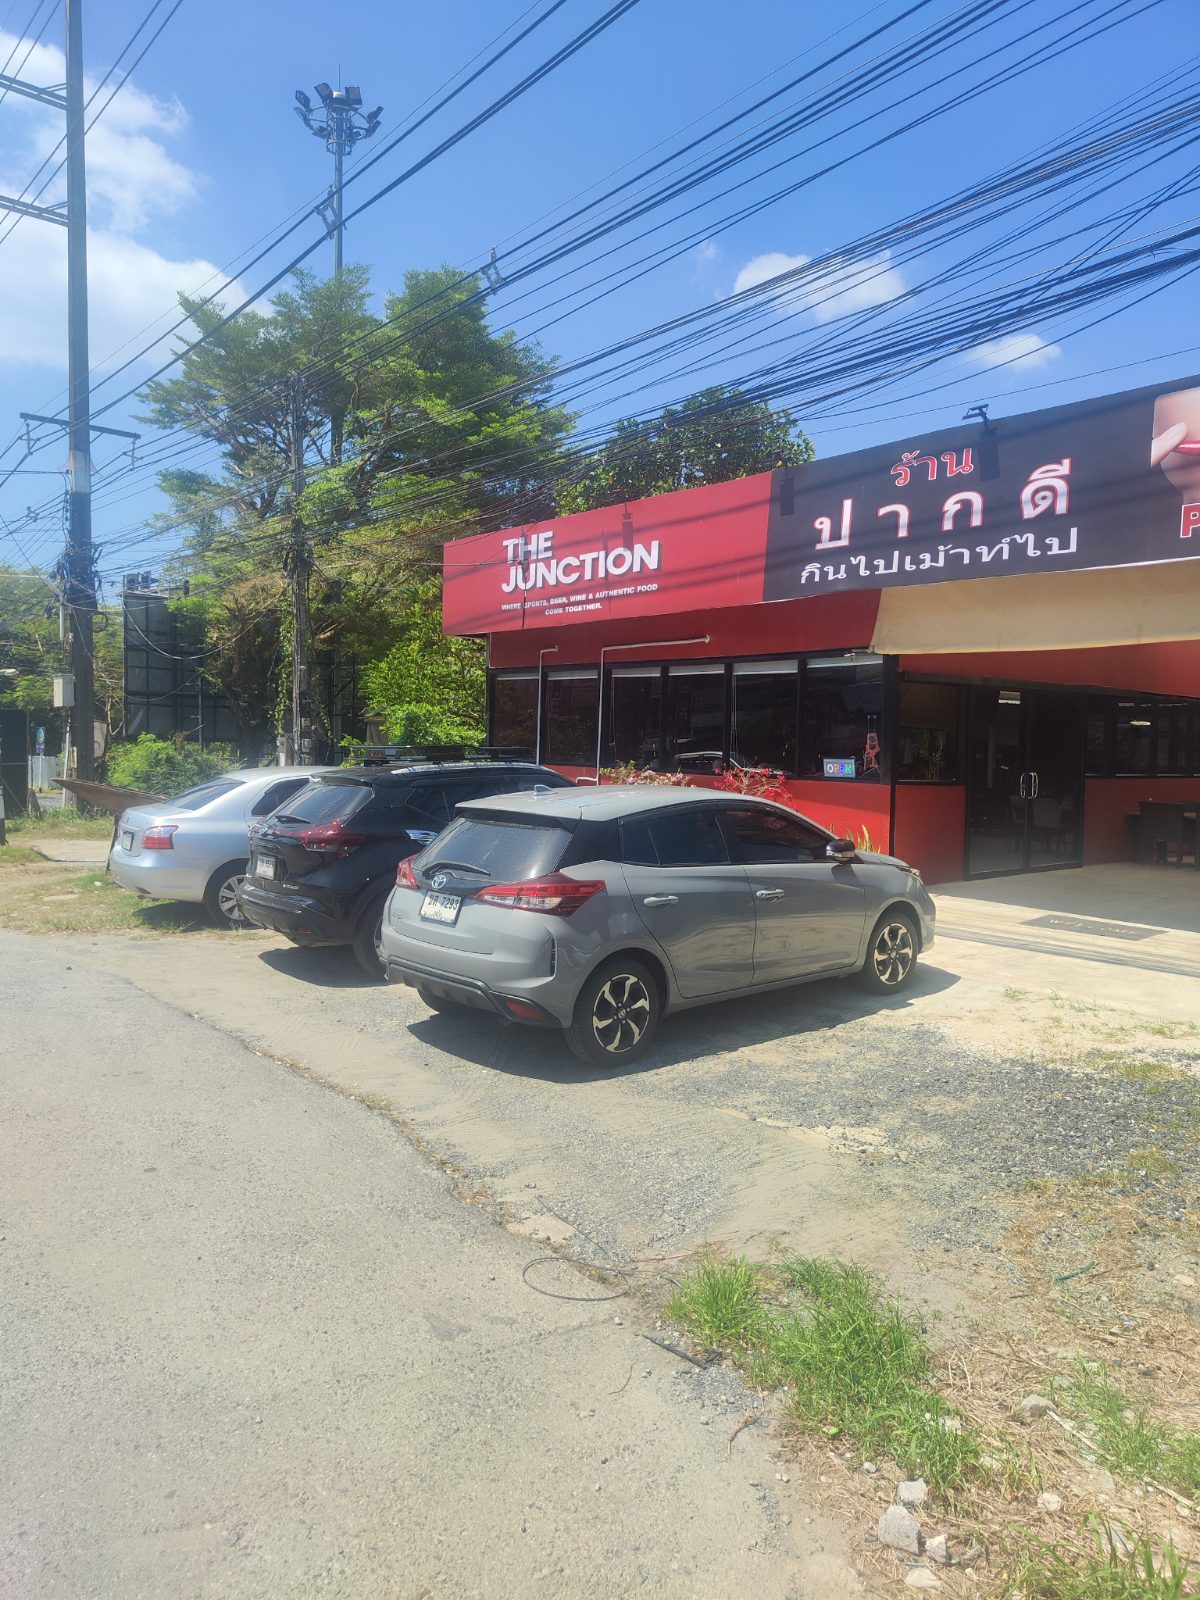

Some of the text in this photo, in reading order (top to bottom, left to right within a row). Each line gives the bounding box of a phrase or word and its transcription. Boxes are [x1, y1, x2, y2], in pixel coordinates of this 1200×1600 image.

[890, 447, 975, 487] ร้าน
[502, 530, 554, 564] THE
[800, 527, 1078, 584] กินไปเม้าท์ไป
[501, 540, 660, 593] JUNCTION
[501, 603, 521, 611] WHERE
[570, 593, 587, 602] WINE
[595, 586, 635, 599] AUTHENTIC
[637, 583, 658, 593] FOOD
[545, 607, 563, 616] COME
[826, 762, 852, 774] OPEN
